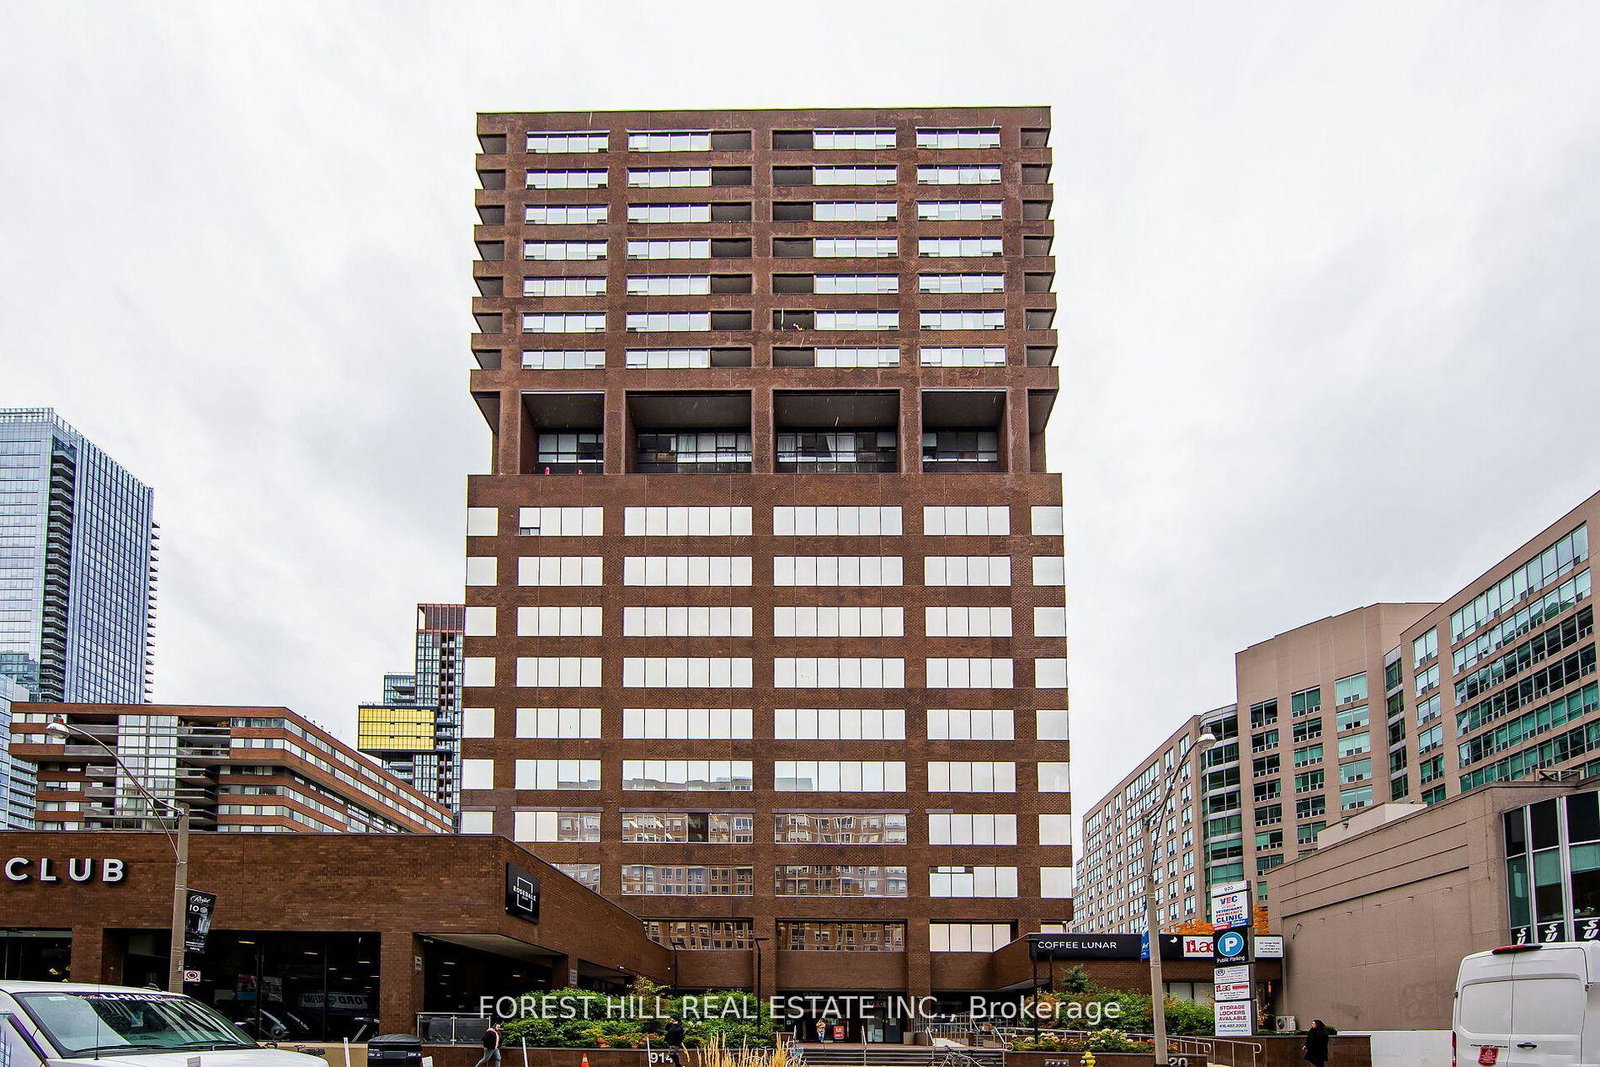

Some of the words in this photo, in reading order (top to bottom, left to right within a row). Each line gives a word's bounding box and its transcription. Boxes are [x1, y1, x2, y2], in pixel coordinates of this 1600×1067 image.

[4, 857, 124, 882] CLUB
[1220, 895, 1238, 905] VEC
[1216, 913, 1243, 924] CLINIC
[1037, 941, 1079, 949] COFFEE
[1081, 941, 1117, 949] LUNAR
[1224, 937, 1238, 952] P
